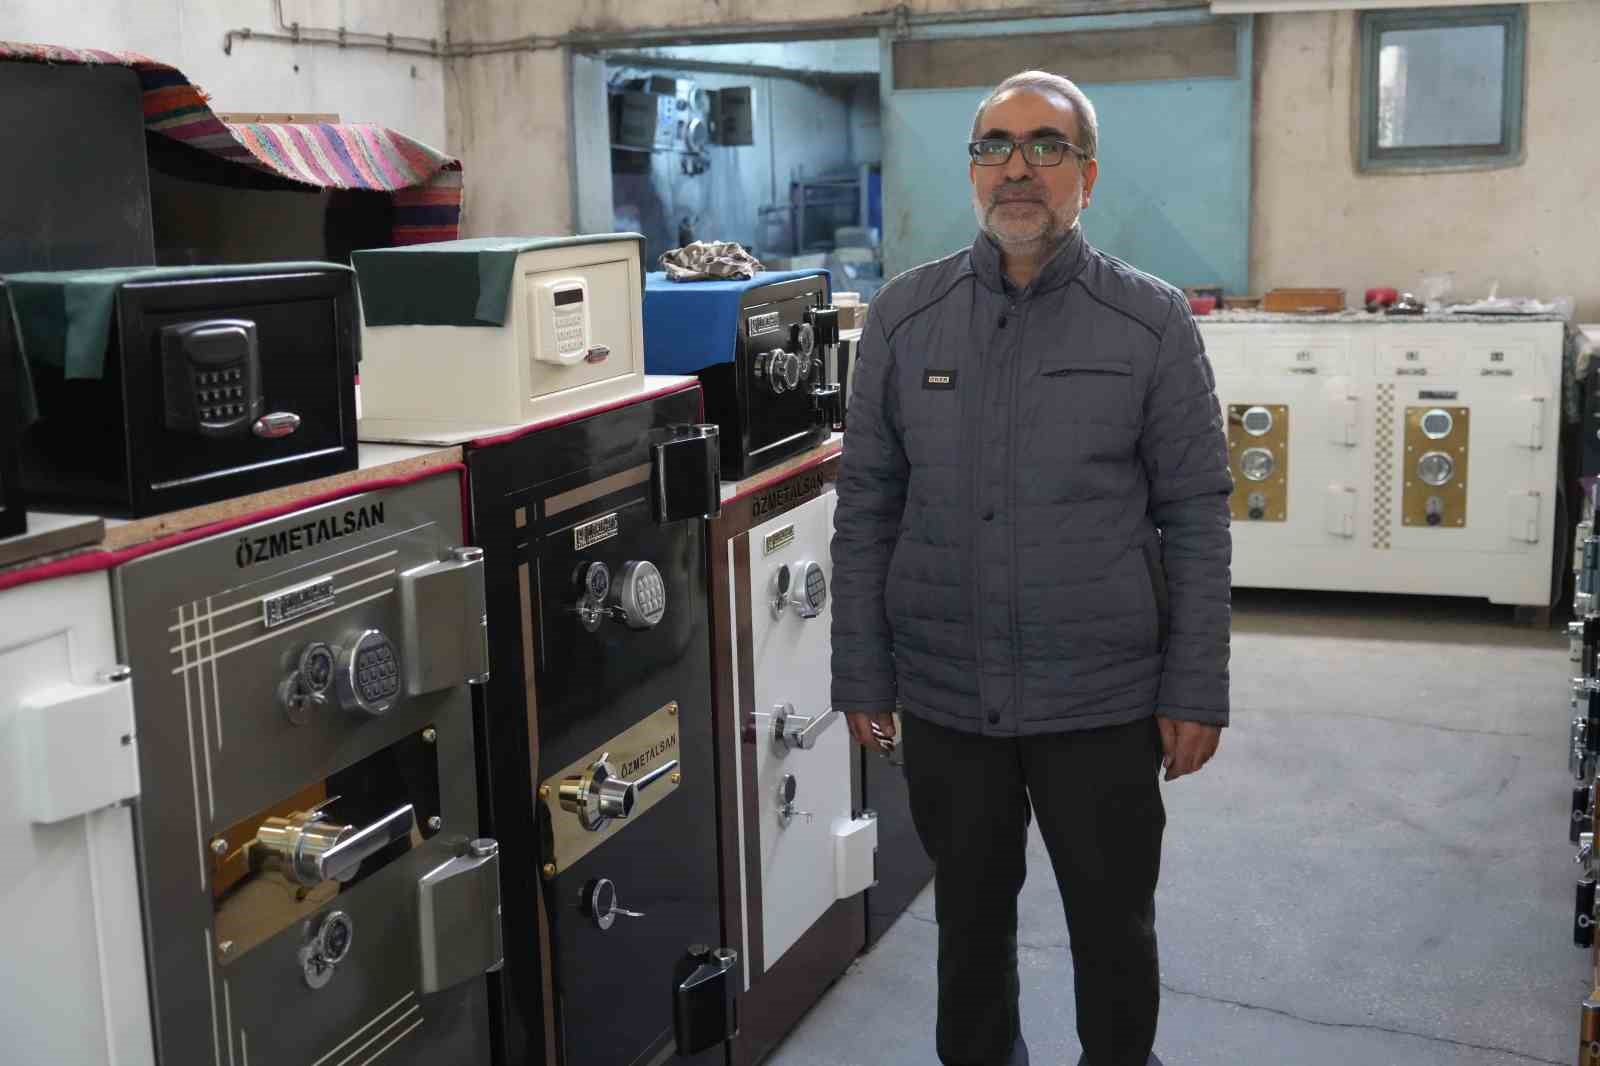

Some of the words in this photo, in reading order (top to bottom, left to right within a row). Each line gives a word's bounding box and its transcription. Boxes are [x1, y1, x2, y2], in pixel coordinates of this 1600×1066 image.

[752, 472, 824, 517] ÖZMETALSAN
[236, 501, 385, 568] ÖZMETALSAN
[621, 734, 676, 778] ÖZMETALSAN
